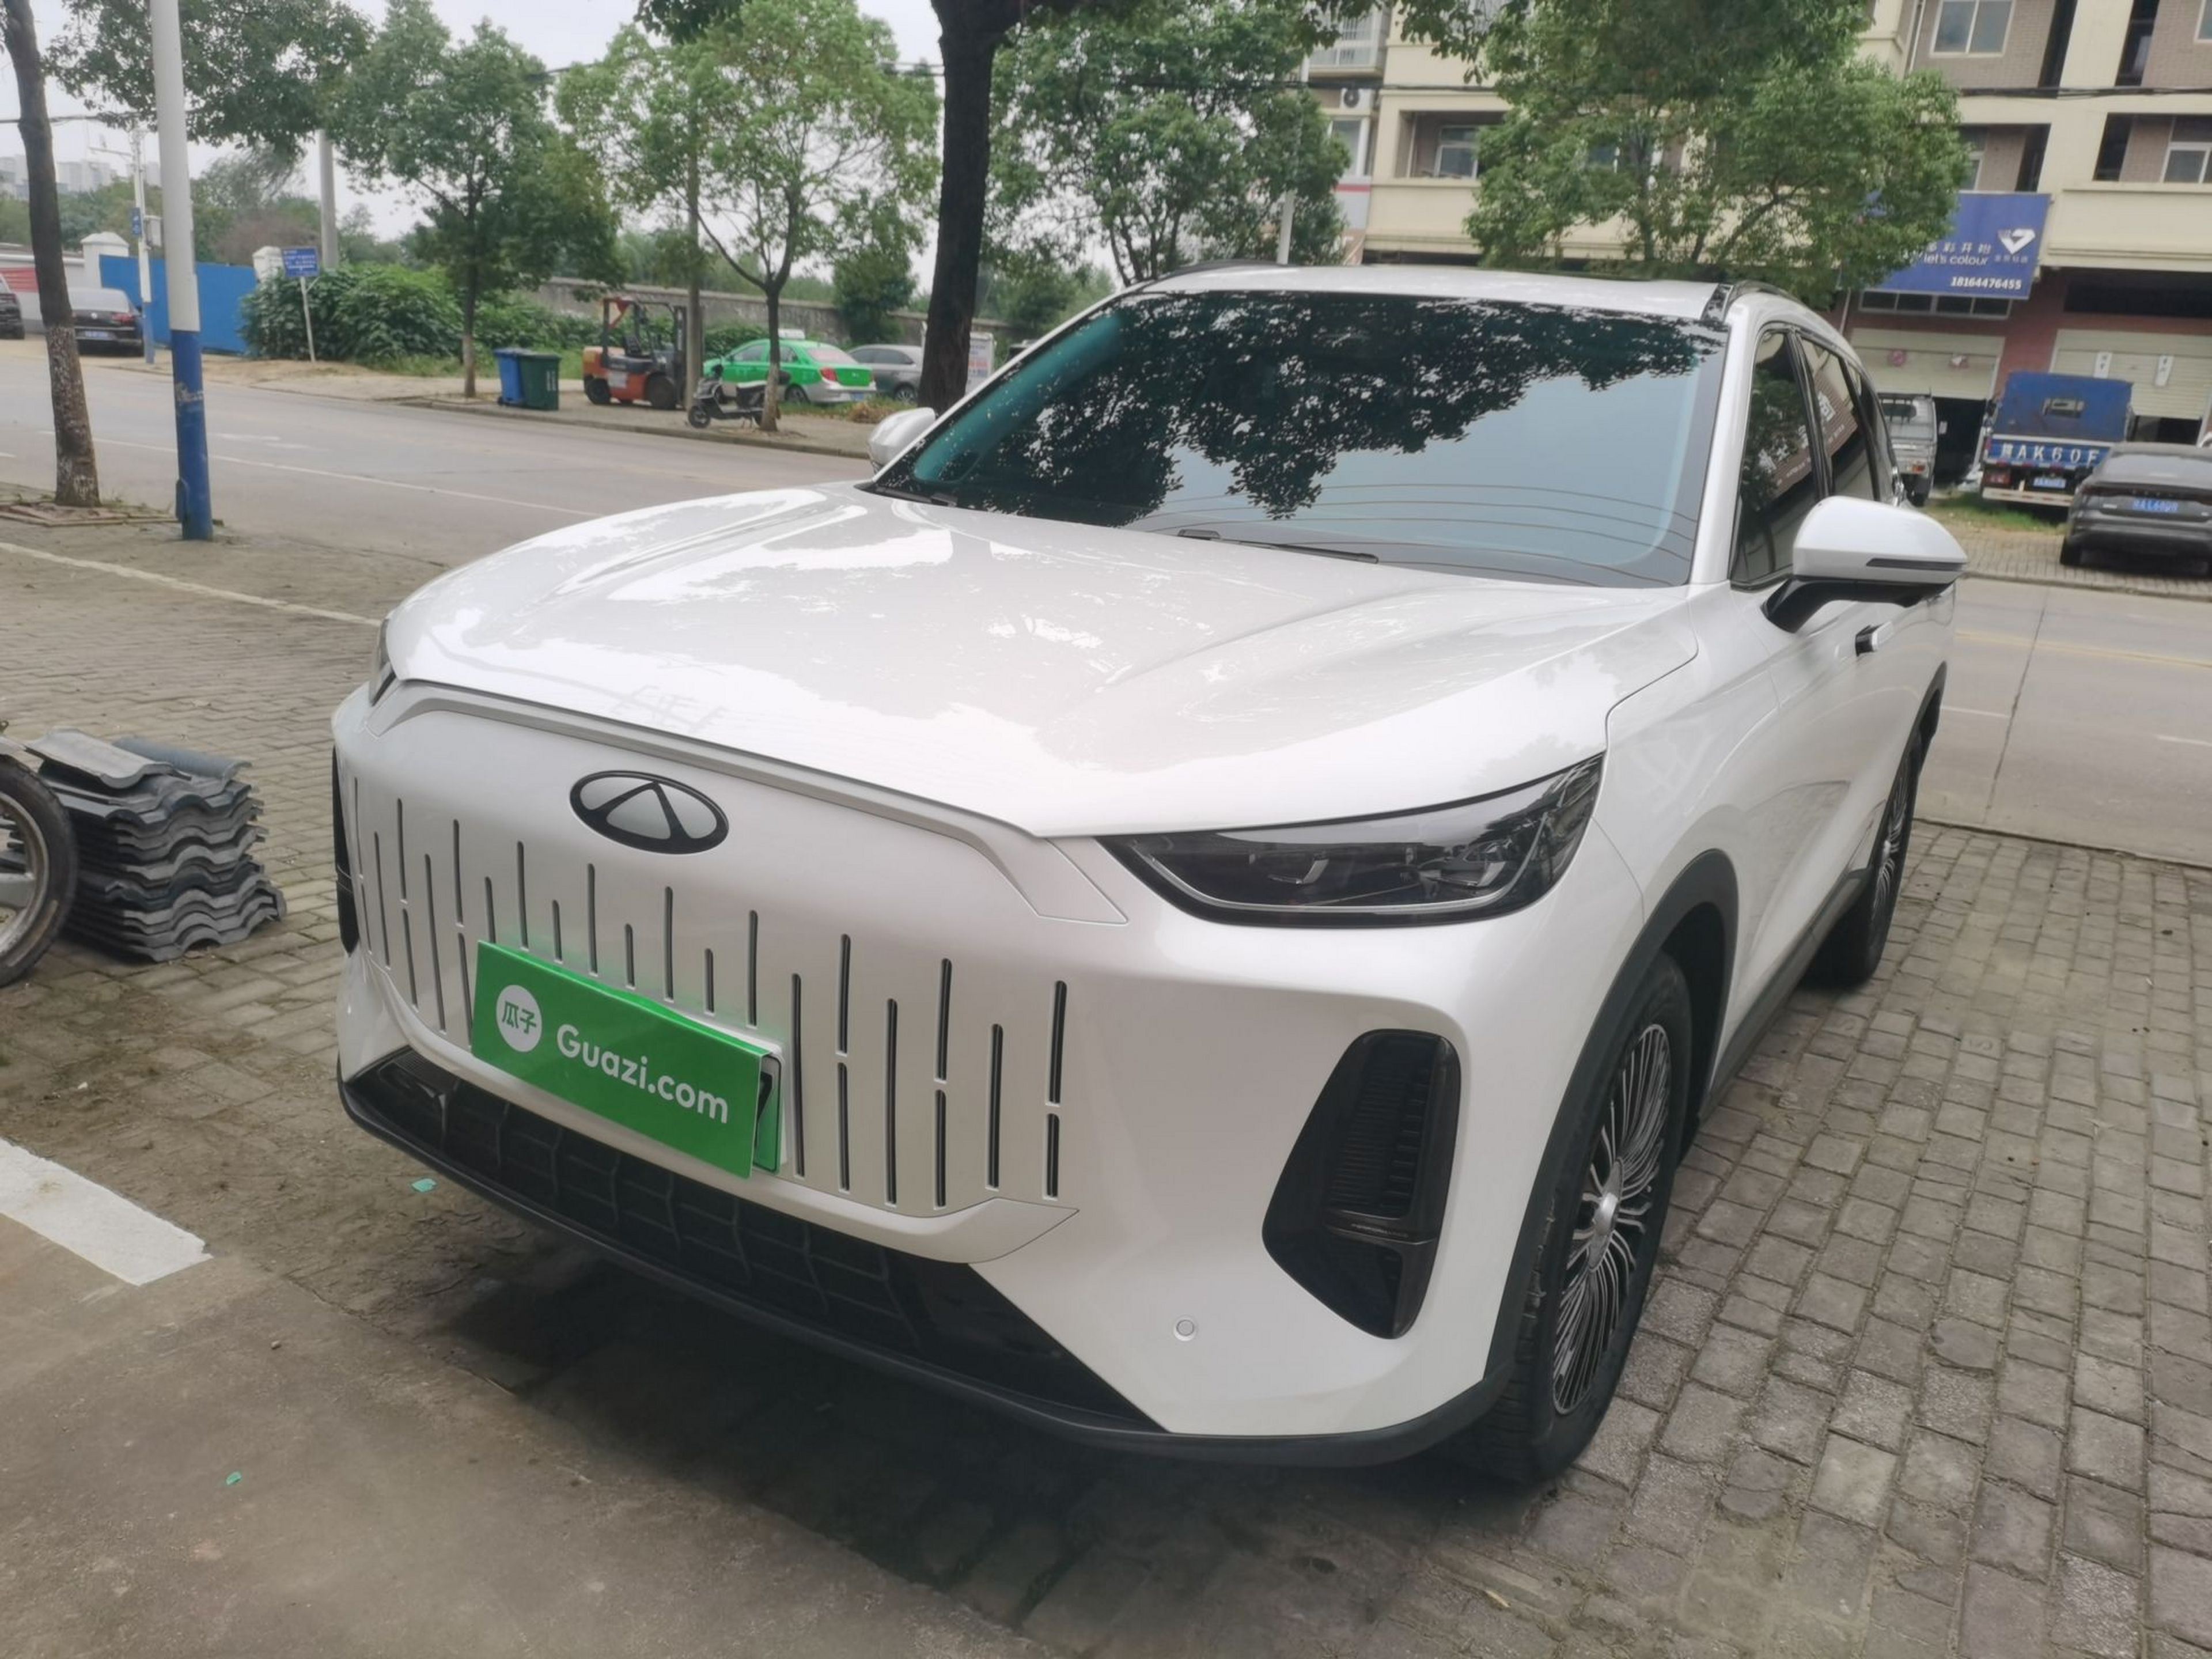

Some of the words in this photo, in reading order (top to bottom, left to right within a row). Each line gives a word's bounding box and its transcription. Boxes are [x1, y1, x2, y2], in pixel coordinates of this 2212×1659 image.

[1949, 255, 1988, 266] colour
[502, 1001, 537, 1034] 瓜子
[556, 1024, 728, 1124] Guazi.com
